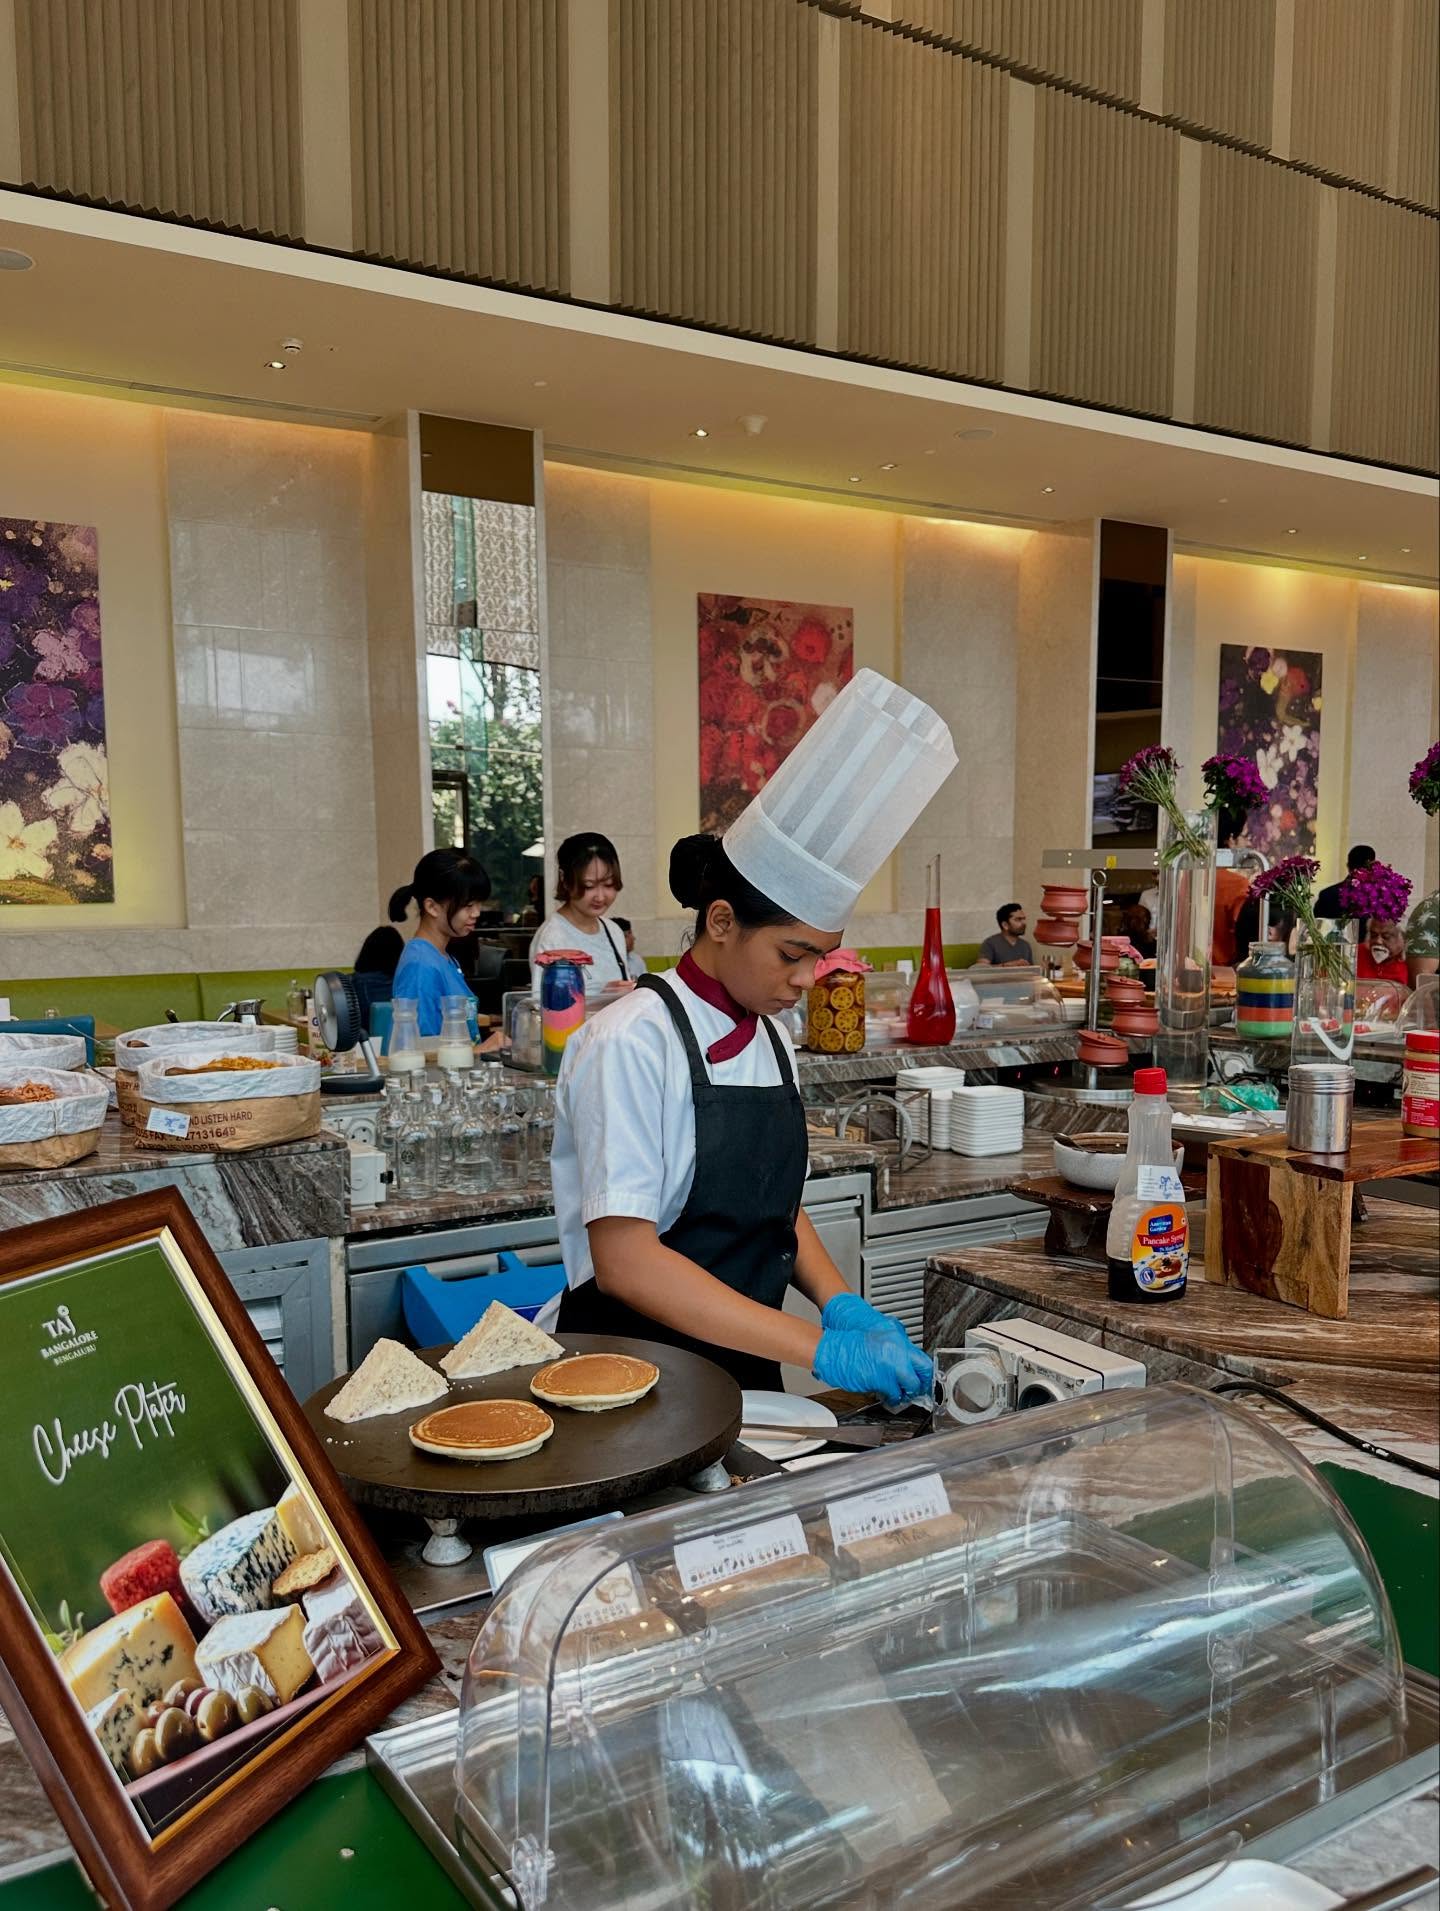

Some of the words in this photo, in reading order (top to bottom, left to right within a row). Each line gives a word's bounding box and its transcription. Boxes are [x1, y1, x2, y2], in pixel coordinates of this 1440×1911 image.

[201, 1112, 229, 1125] LISTEN
[230, 1111, 253, 1121] HARD
[1143, 1236, 1170, 1245] Pancake
[42, 1305, 76, 1338] TAJ
[40, 1330, 98, 1358] BANGALORE
[53, 1344, 97, 1366] BENGALURU
[33, 1417, 116, 1485] Cheese
